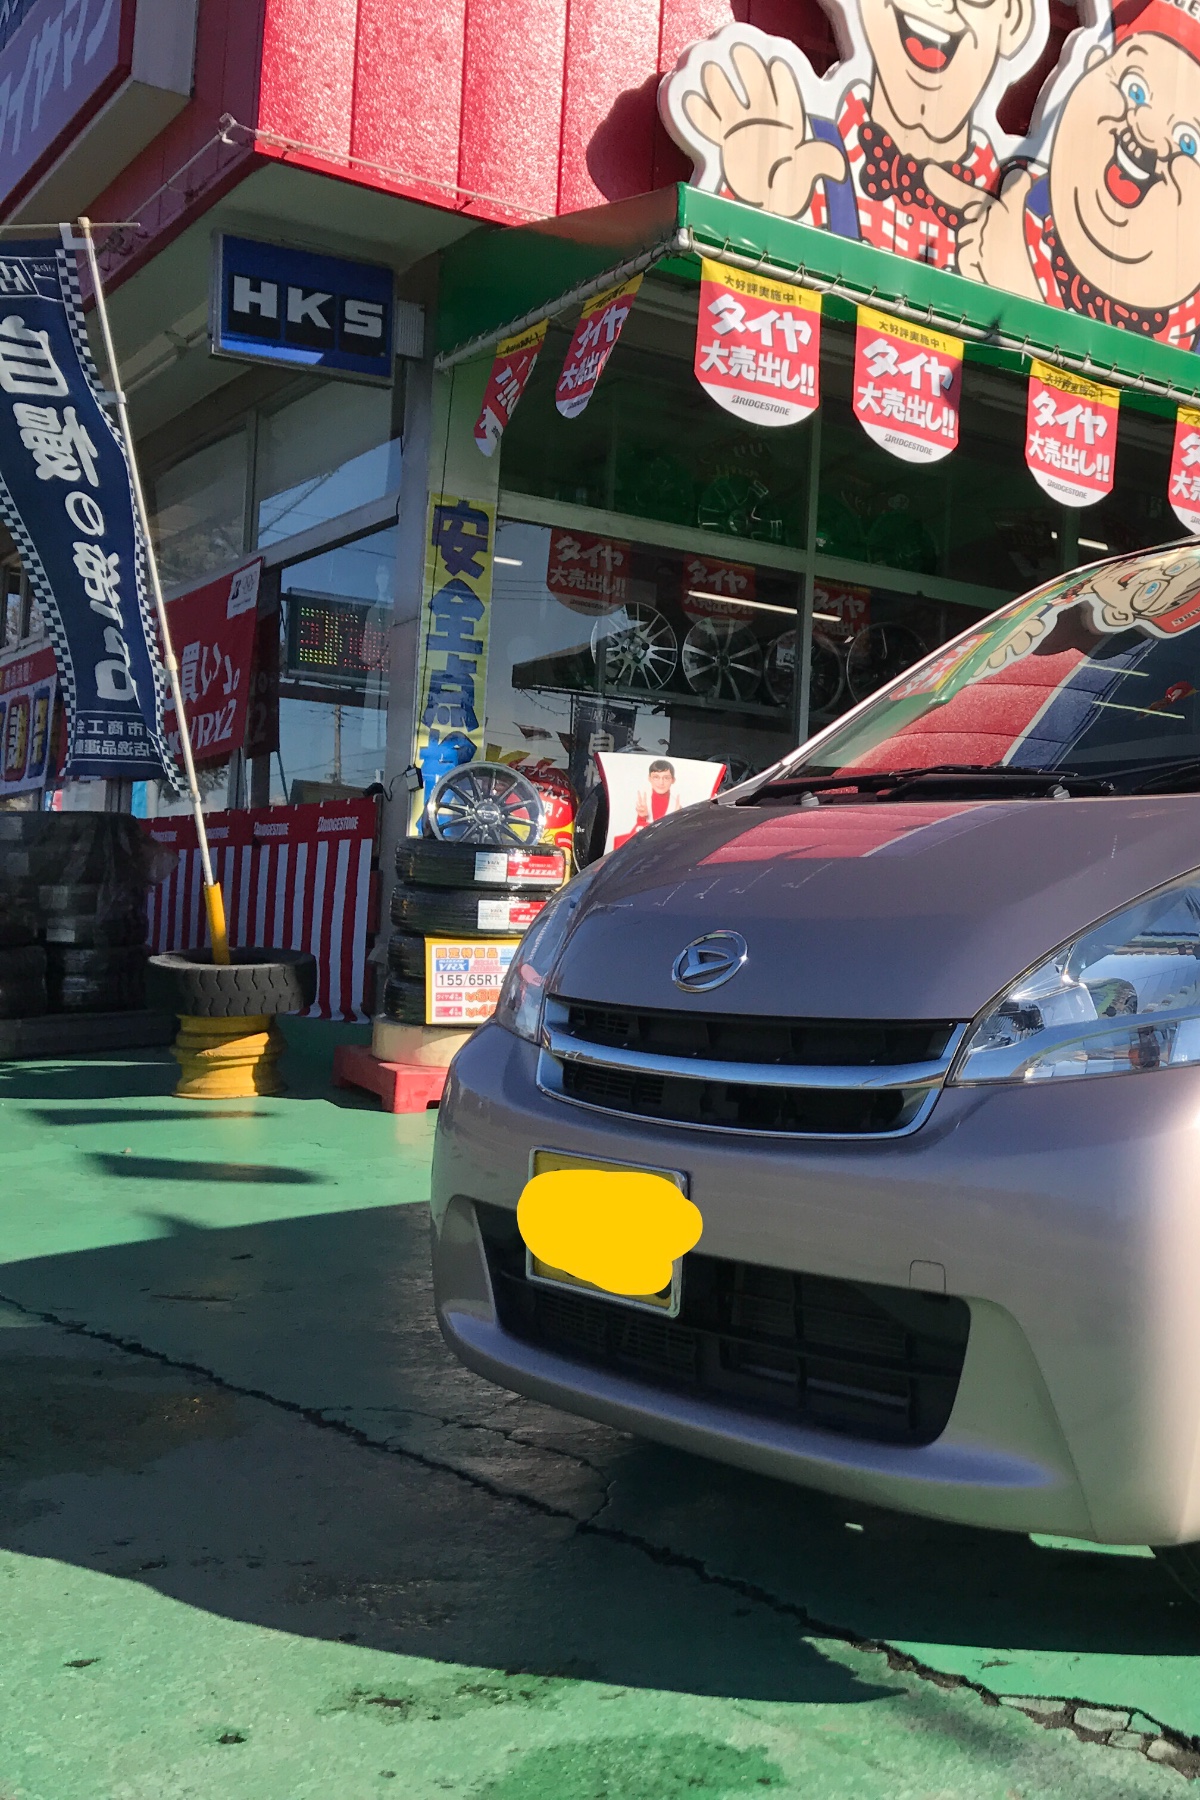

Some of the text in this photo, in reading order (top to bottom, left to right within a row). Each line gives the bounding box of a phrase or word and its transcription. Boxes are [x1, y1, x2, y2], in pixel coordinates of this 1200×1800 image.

[233, 275, 384, 338] HKS
[724, 275, 803, 305] 大好評実施中!
[707, 293, 812, 353] タイヤ
[878, 320, 948, 351] 大好評実施中!
[700, 340, 816, 397] 大売出し!!
[862, 338, 954, 397] タイヤ
[731, 394, 791, 416] BRIDGESTONE
[857, 381, 955, 438] 大売出し!!
[1032, 390, 1109, 445] タイヤ
[884, 433, 933, 455] BRIDGESTONE
[1028, 430, 1110, 483] 大売出し!!
[1047, 478, 1088, 499] BRIDGESTONE
[555, 536, 624, 571] タイヤ
[687, 560, 748, 593] タイヤ
[317, 815, 359, 833] BRIDGESTONE
[438, 963, 466, 971] VRX
